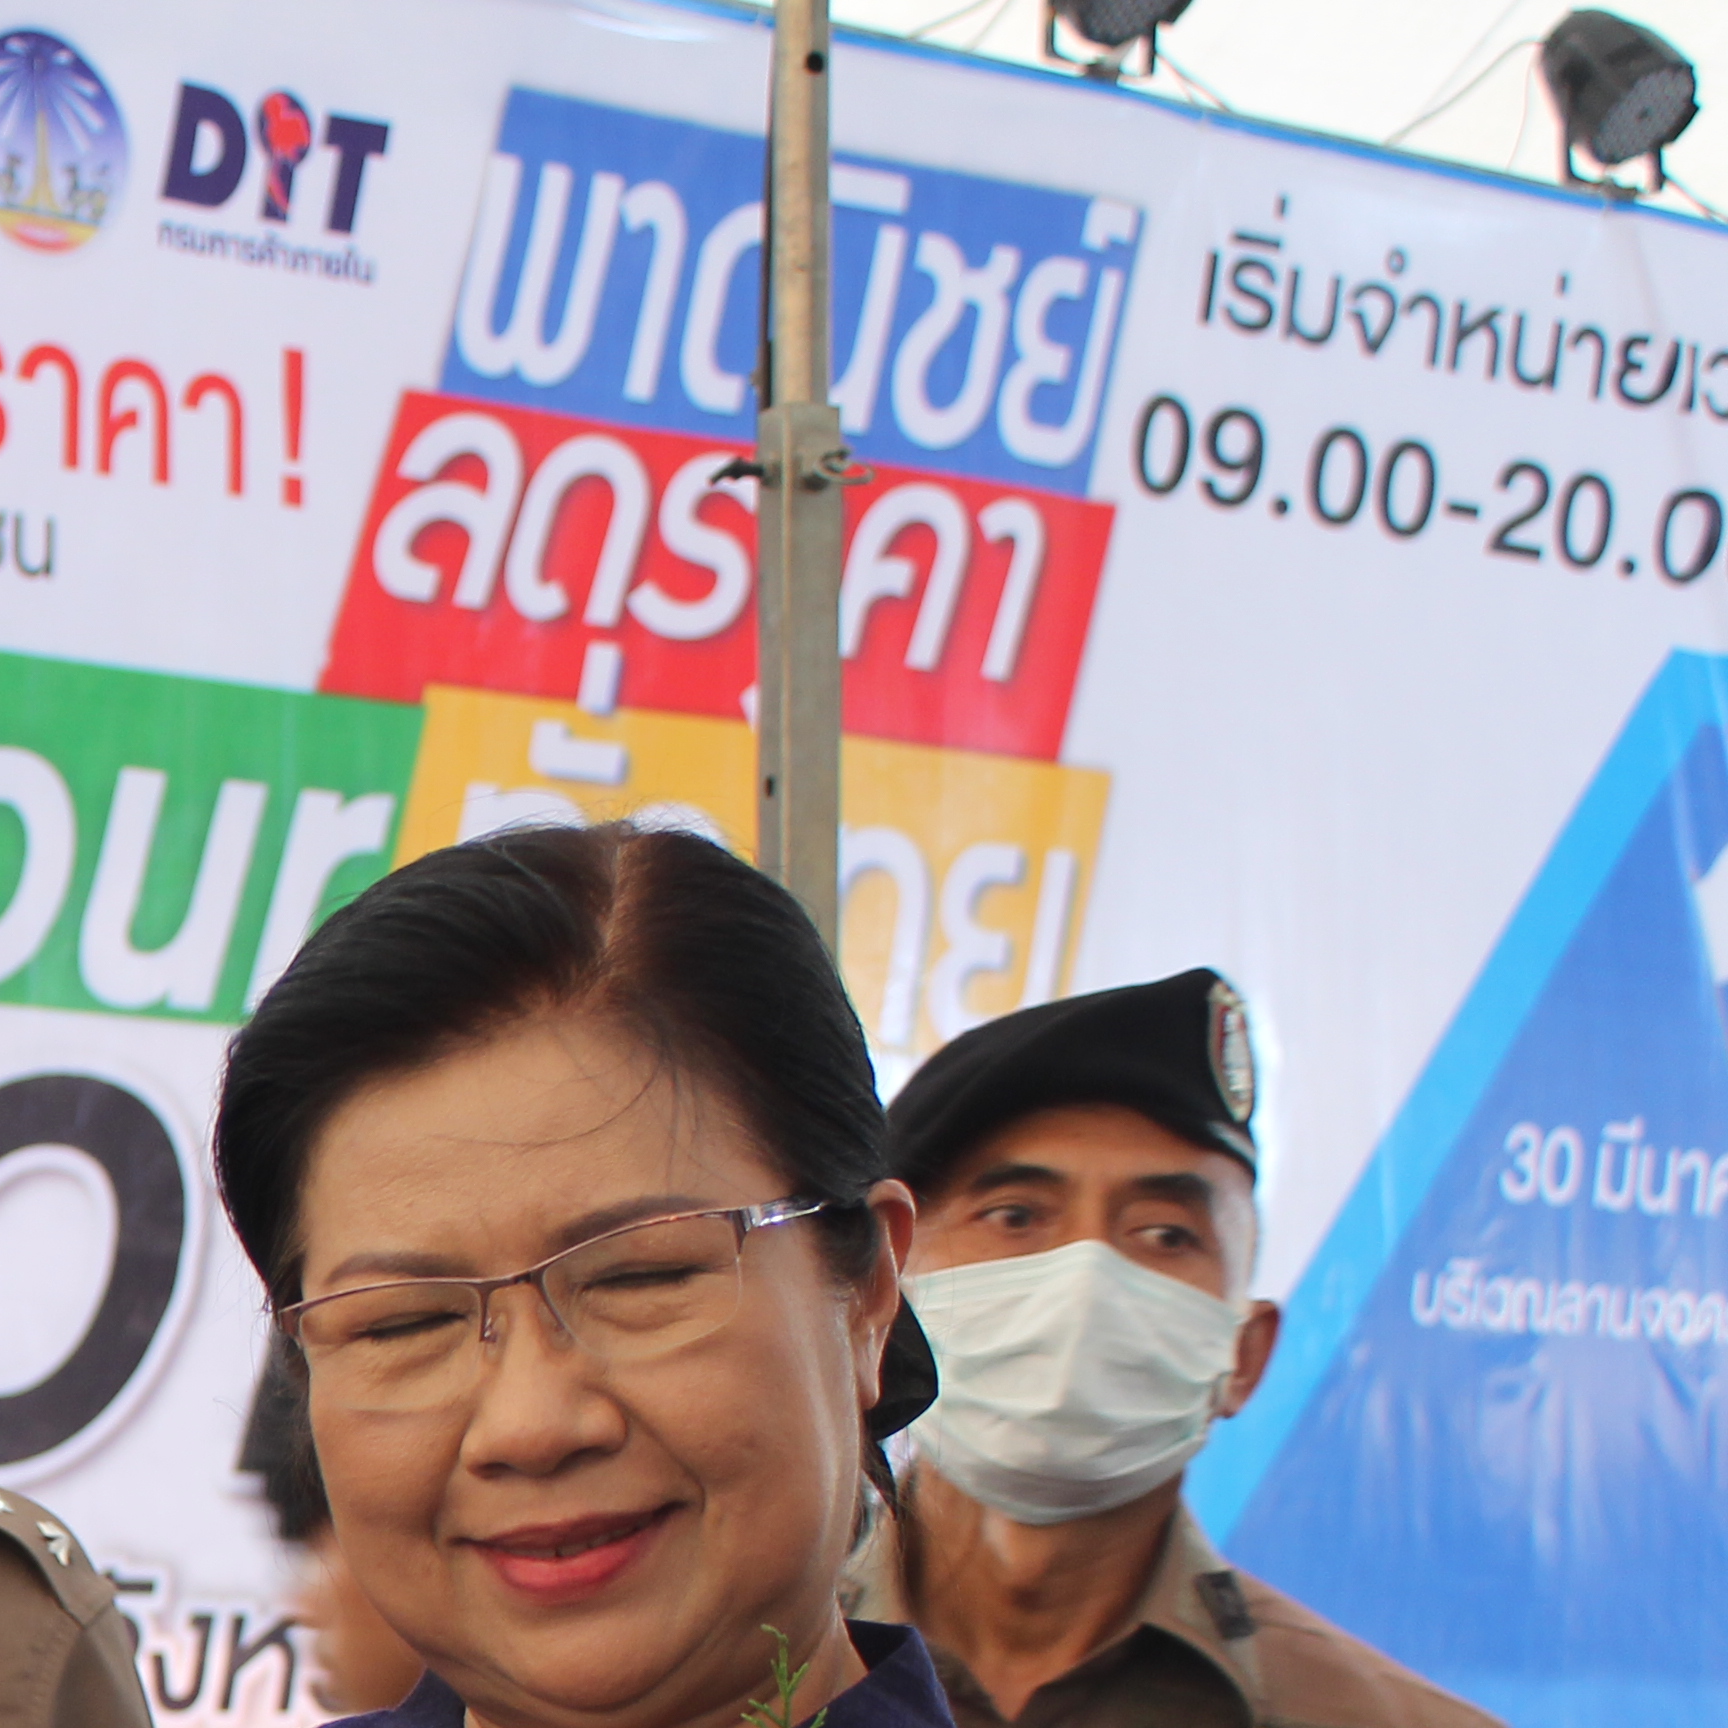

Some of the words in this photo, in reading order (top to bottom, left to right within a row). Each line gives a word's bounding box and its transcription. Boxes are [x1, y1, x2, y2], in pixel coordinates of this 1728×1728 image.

[160, 80, 391, 235] DIT
[372, 412, 1044, 683] ลดรคา
[1134, 394, 1728, 585] 09.00-20.0
[1500, 1122, 1584, 1206] 30
